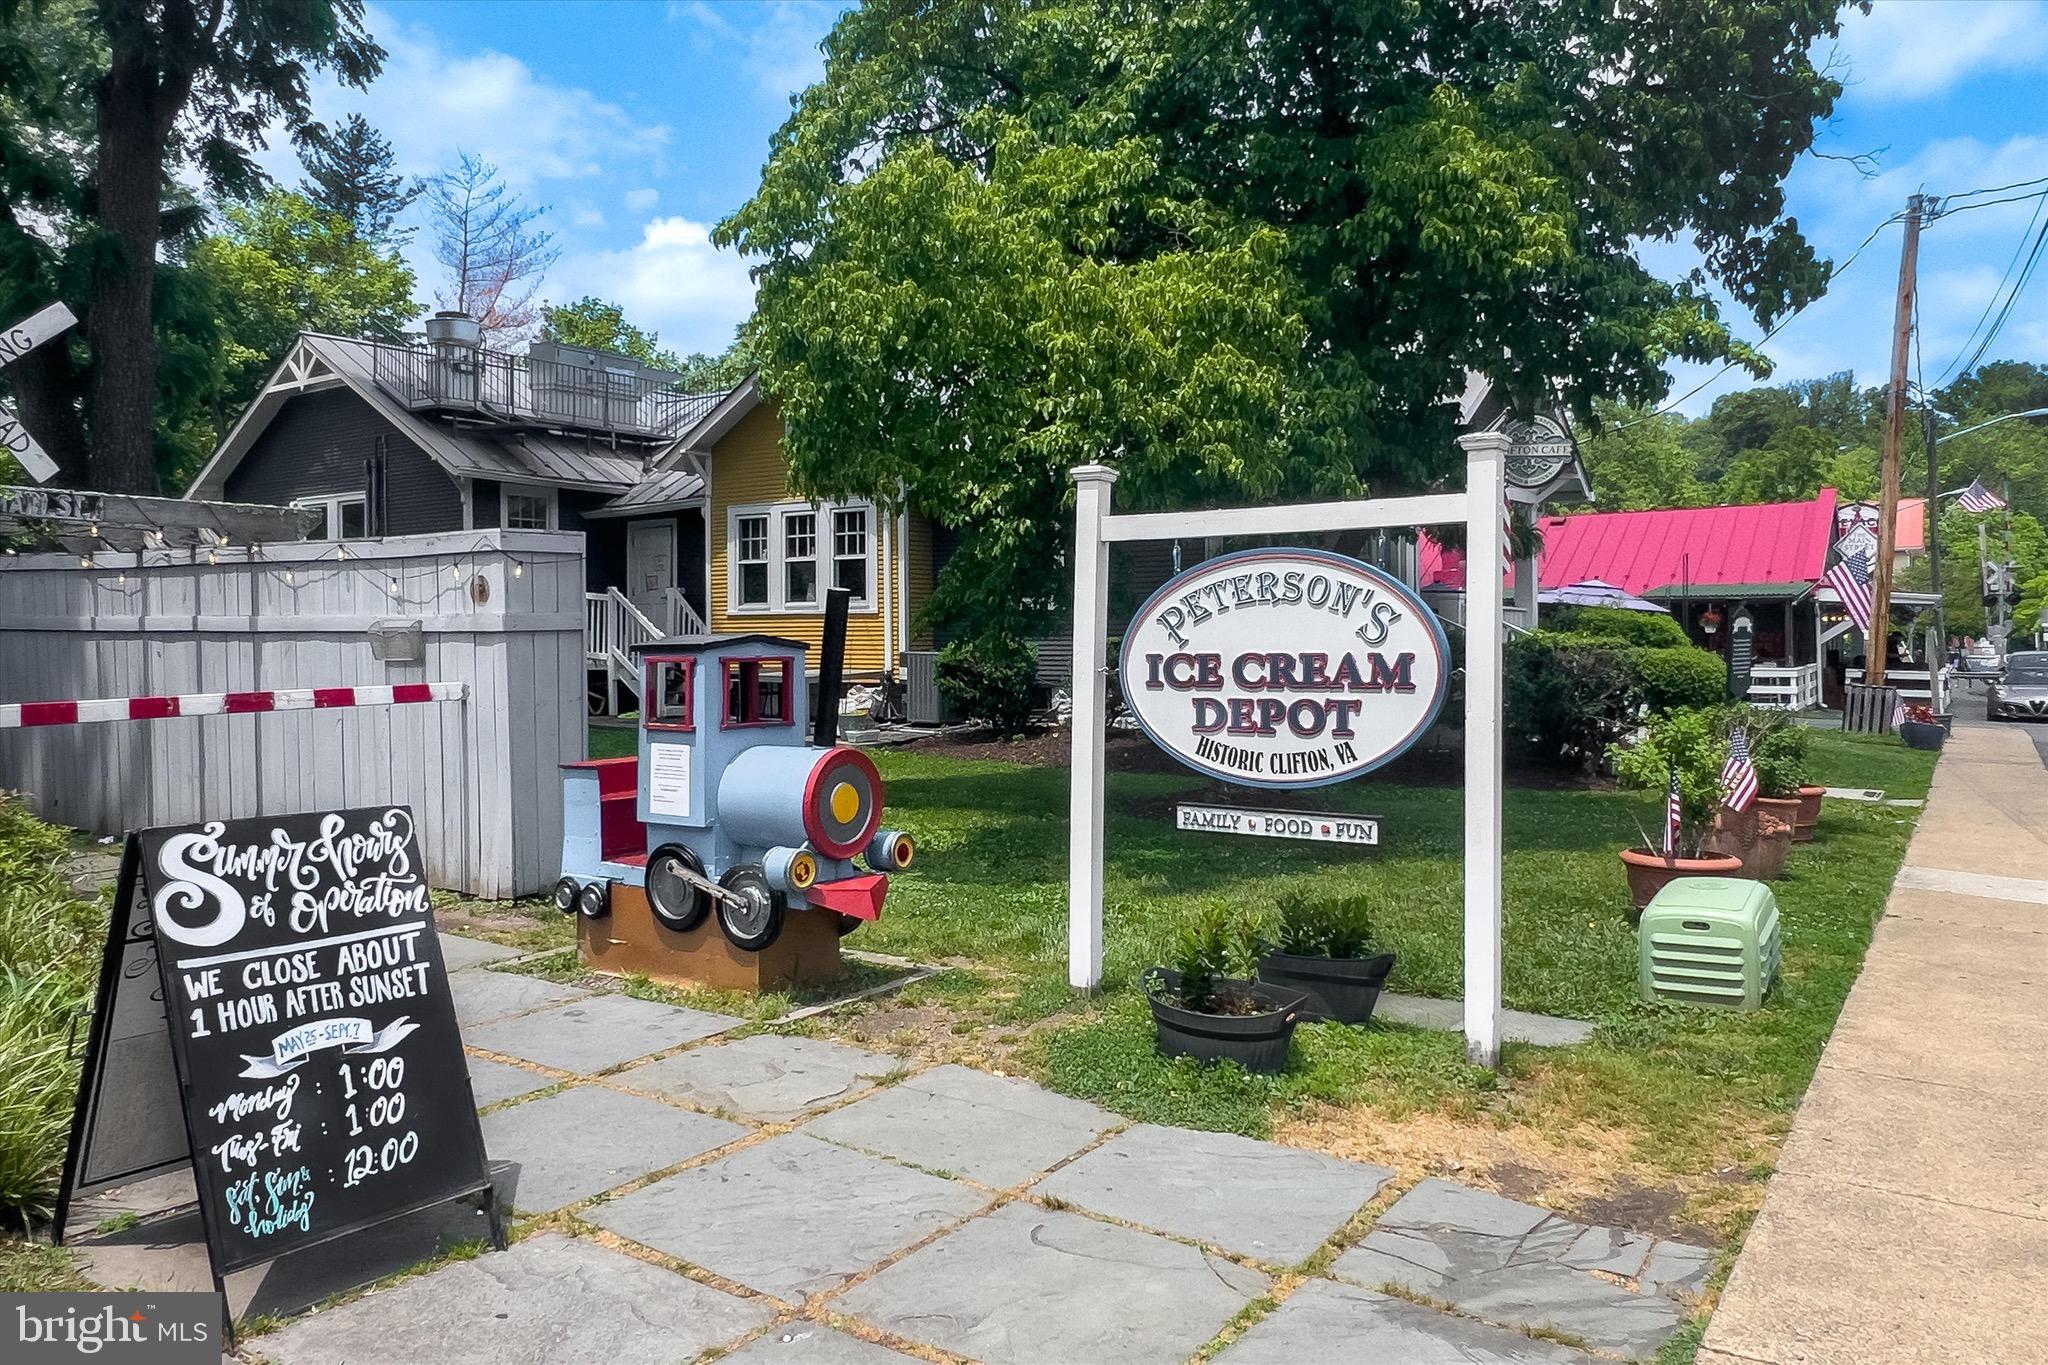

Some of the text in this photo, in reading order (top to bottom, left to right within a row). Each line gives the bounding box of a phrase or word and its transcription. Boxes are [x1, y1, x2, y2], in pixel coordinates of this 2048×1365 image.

[0, 405, 30, 452] AD
[1156, 571, 1402, 649] PETERSON'S
[1145, 652, 1416, 693] ICE CREAM
[1191, 697, 1362, 740] DEPOT
[1195, 735, 1359, 775] HISTORIC CLIFTON, VA
[1182, 811, 1373, 840] FAMILY FOOD FUN
[250, 873, 429, 934] of Operation
[183, 931, 422, 1002] WE CLOSE ABOUT
[190, 962, 431, 1038] 1 HOUR AFTER SUNSET
[278, 1030, 305, 1058] MAY
